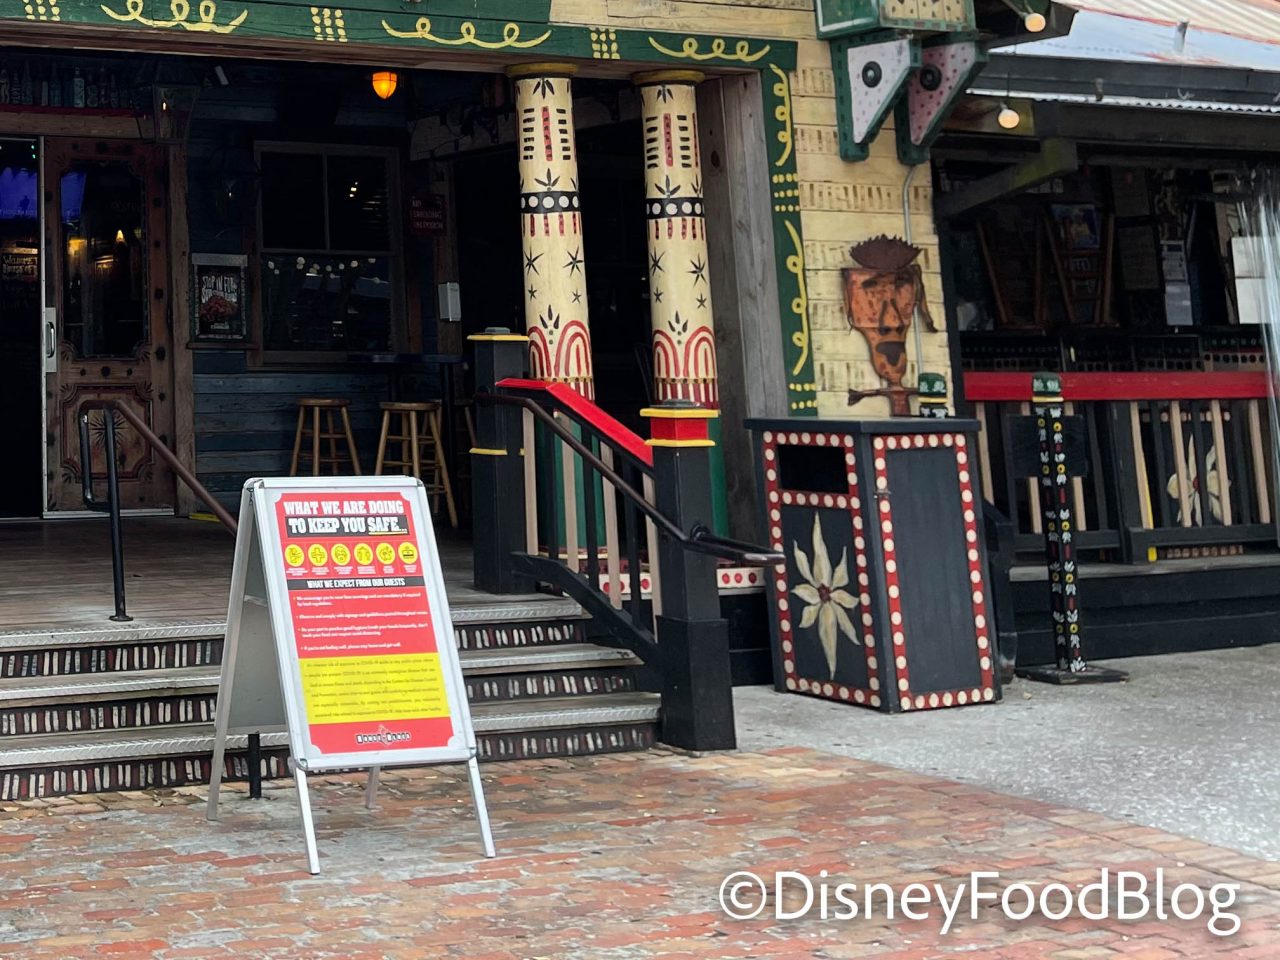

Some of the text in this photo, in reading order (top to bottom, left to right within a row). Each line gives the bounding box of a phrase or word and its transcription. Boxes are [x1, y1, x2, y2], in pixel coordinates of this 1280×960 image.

[284, 500, 404, 516] WHAT WE ARE DOING
[288, 518, 307, 534] TO
[309, 518, 341, 533] KEEP
[342, 517, 366, 533] YOU
